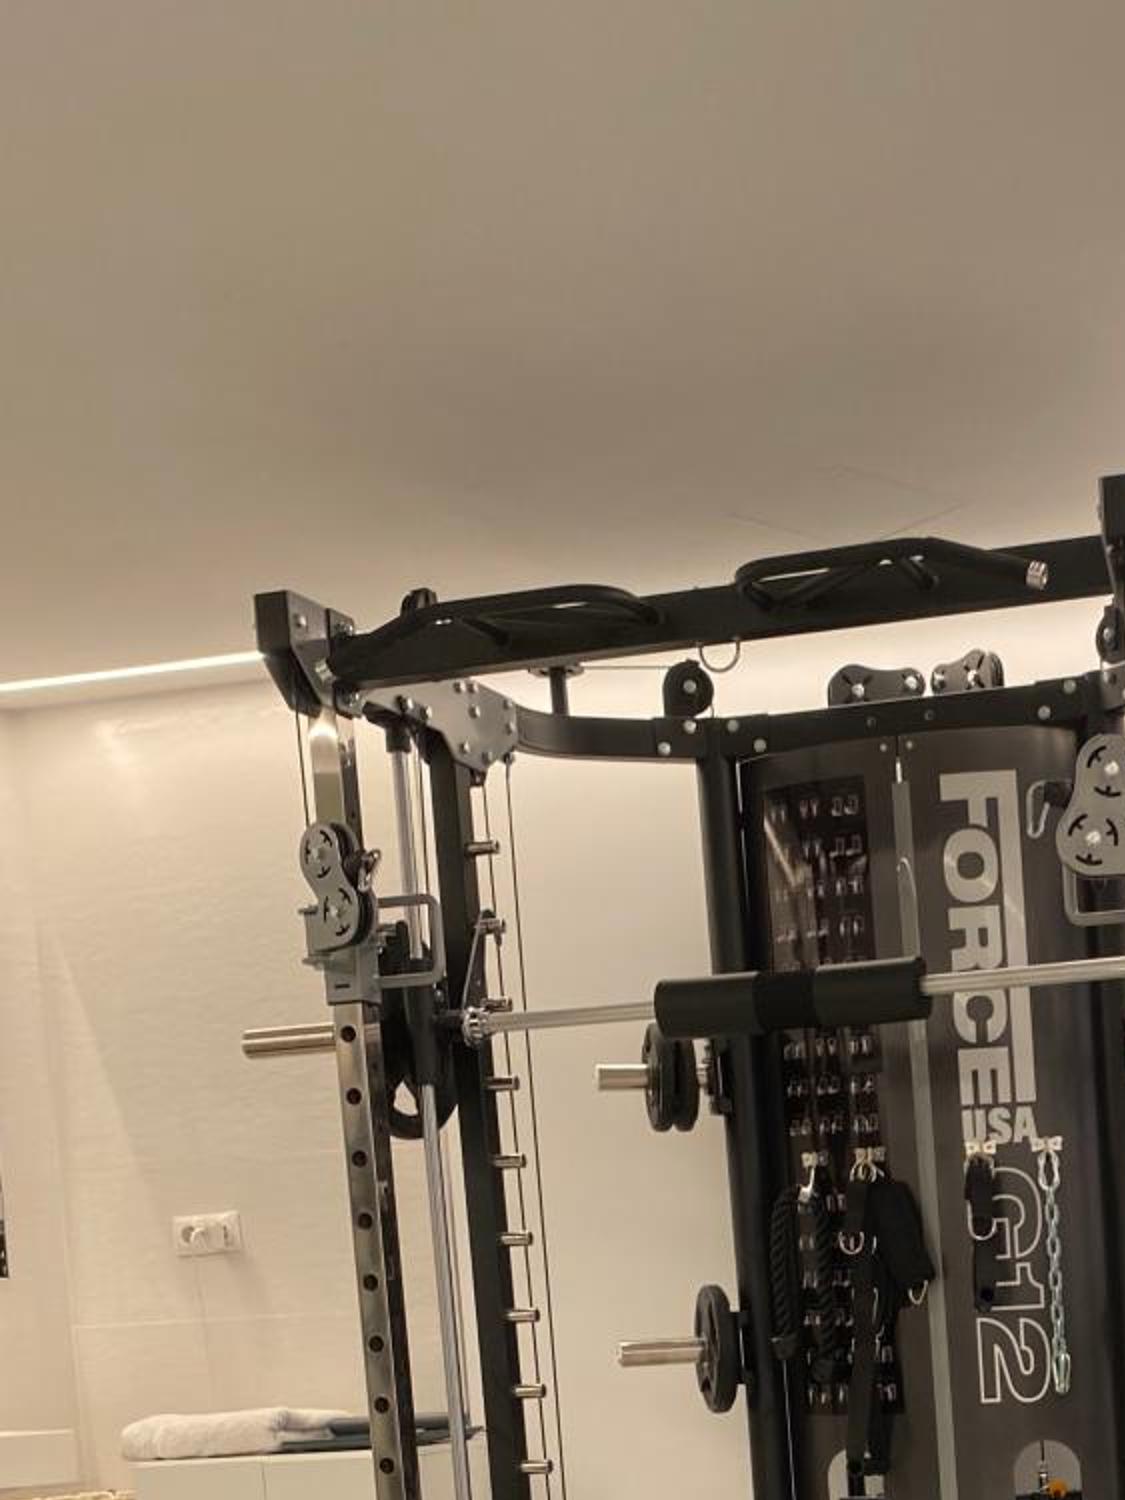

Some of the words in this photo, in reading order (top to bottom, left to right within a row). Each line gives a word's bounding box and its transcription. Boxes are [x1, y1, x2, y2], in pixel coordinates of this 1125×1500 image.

[938, 769, 1037, 1105] FORCE
[961, 1105, 1038, 1146] USA
[974, 1166, 1052, 1404] G12
